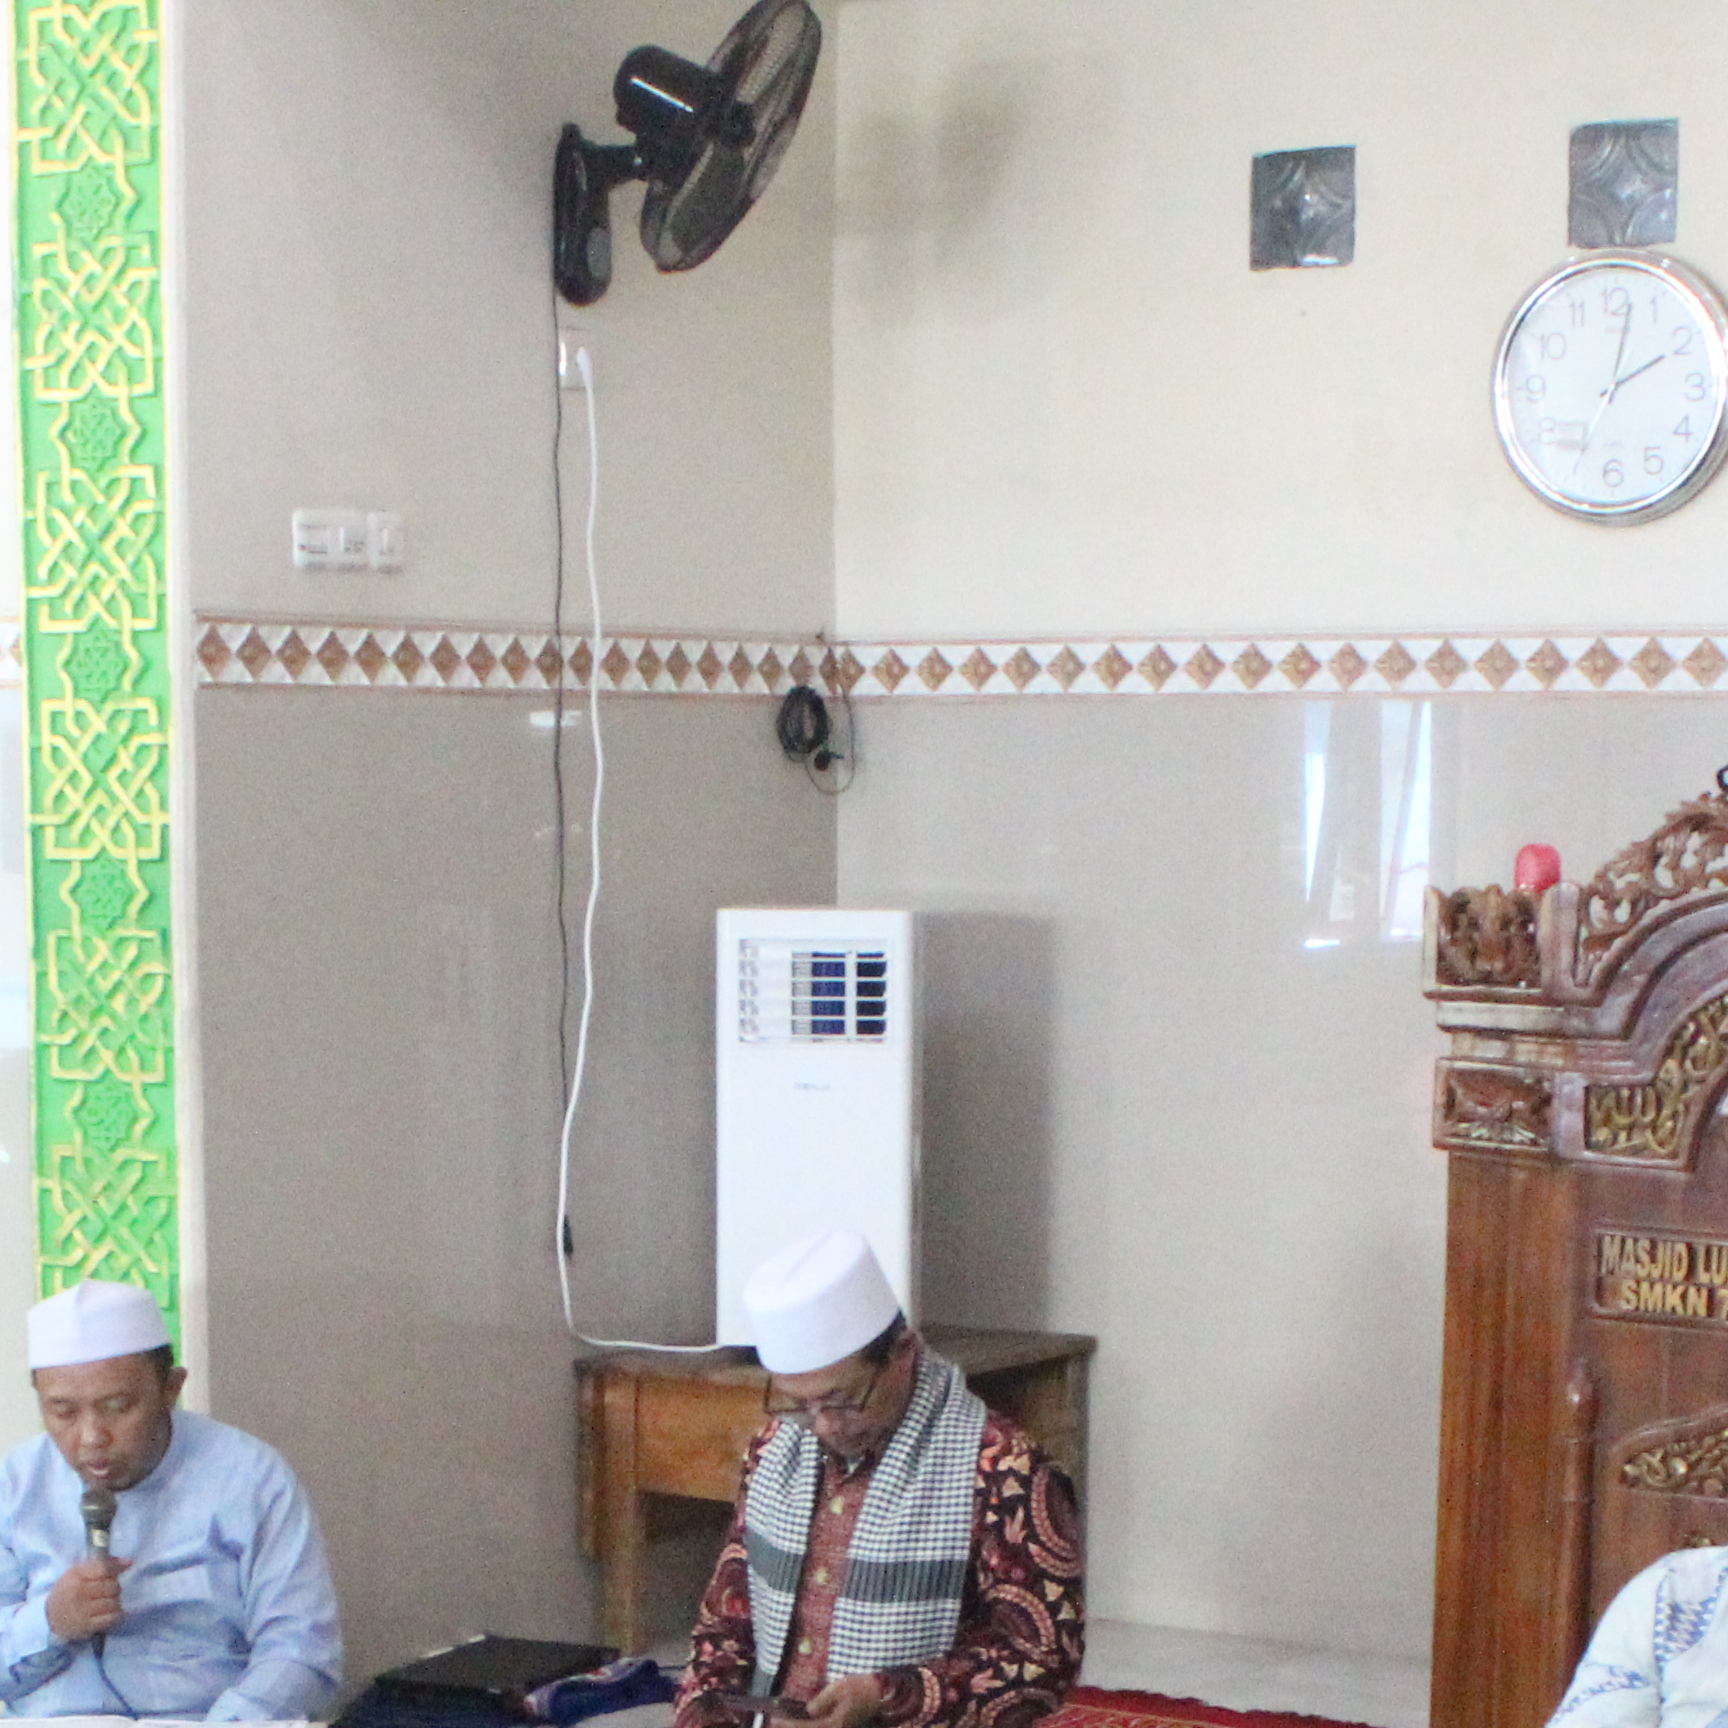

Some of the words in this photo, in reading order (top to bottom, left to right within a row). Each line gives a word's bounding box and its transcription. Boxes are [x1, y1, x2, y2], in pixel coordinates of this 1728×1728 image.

[1568, 300, 1586, 328] 11
[1600, 286, 1631, 317] 12
[1649, 295, 1658, 324] 1
[1539, 332, 1568, 361] 10
[1672, 325, 1693, 356] 2
[1525, 374, 1546, 403] 9
[1684, 372, 1706, 402] 3
[1672, 414, 1694, 443] 4
[1602, 458, 1625, 488] 6
[1643, 446, 1665, 476] 5
[1599, 1234, 1690, 1280] MASJID
[1622, 1279, 1709, 1318] SMKN
